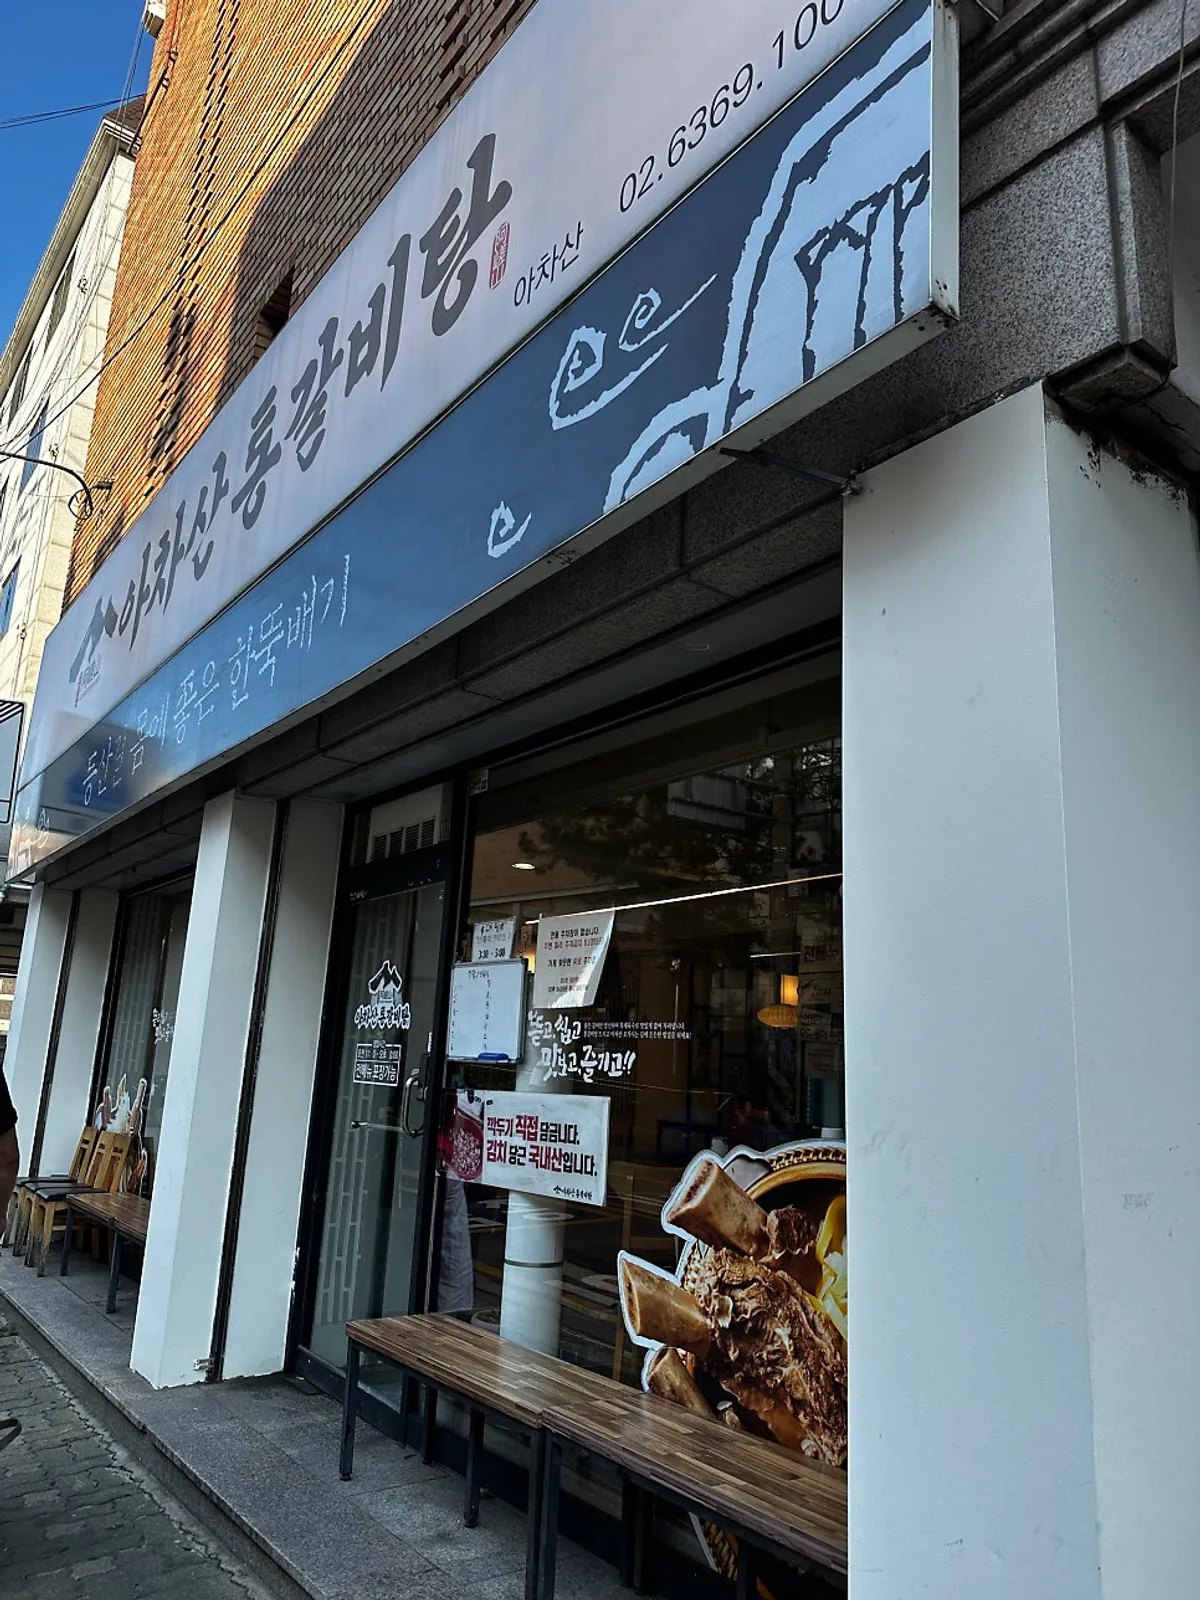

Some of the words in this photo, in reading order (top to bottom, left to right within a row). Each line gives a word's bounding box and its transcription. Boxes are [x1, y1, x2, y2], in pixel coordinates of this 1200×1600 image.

[514, 221, 584, 307] 아차산
[174, 660, 220, 745] 좋은
[580, 1045, 636, 1083] 즐기고!!
[487, 1117, 513, 1137] 깍두기
[516, 1114, 539, 1142] 직접
[487, 1140, 507, 1163] 김치
